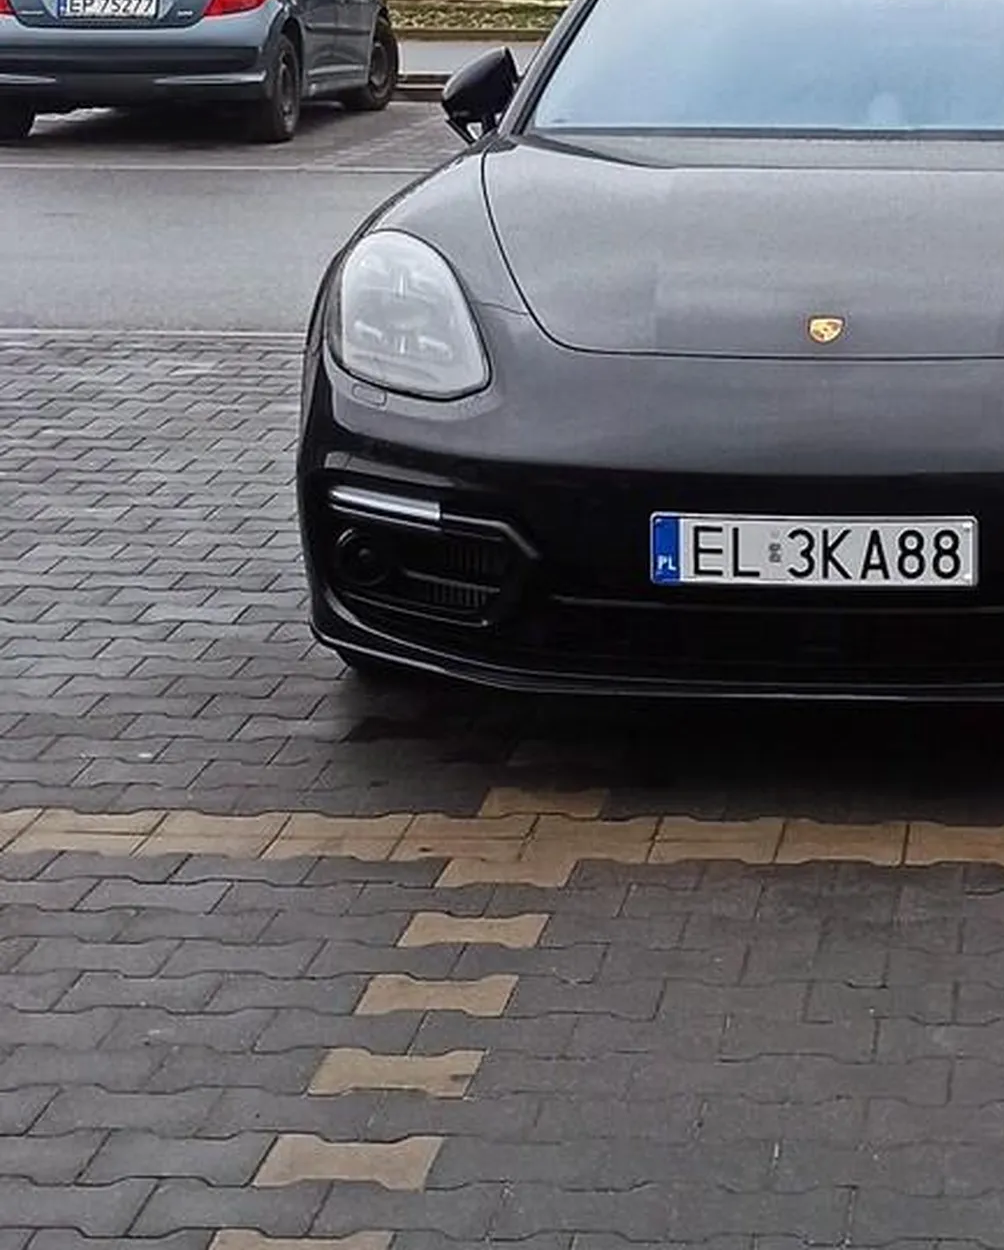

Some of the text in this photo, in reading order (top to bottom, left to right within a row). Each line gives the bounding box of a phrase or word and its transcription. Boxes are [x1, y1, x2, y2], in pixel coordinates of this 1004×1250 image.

[657, 556, 677, 572] PL
[693, 526, 961, 580] EL 3KA88
